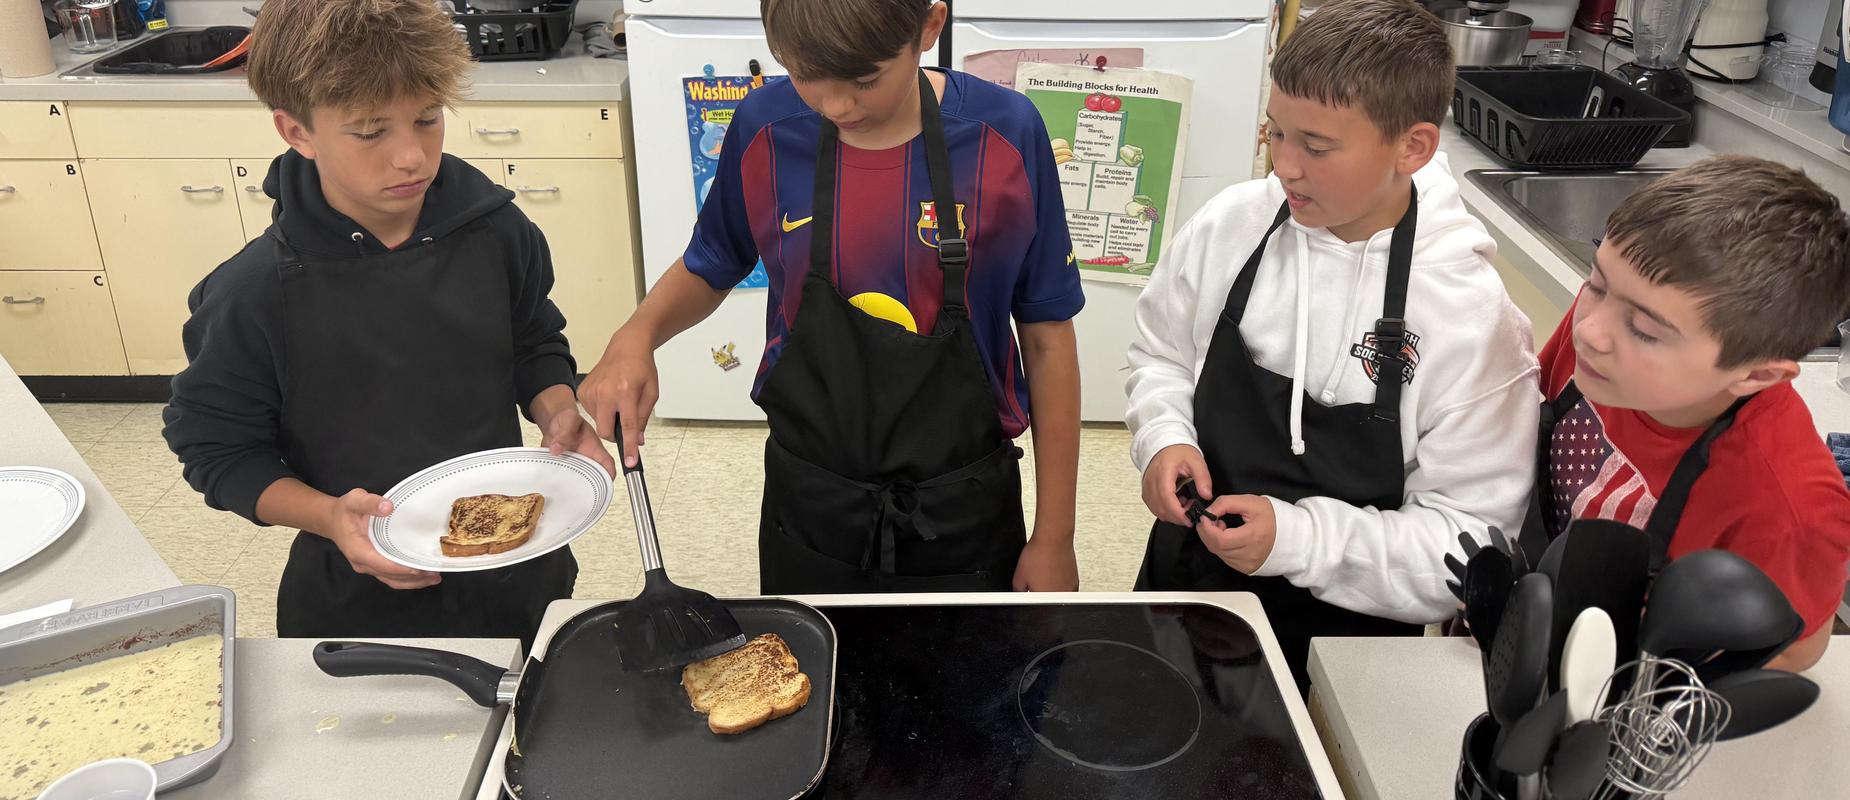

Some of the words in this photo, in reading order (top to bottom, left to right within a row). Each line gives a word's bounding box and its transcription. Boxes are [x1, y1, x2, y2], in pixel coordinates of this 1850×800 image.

[1028, 78, 1044, 86] The
[1046, 79, 1083, 90] Building
[1085, 82, 1113, 91] Blocks
[1115, 84, 1127, 92] for
[1129, 85, 1159, 94] Health
[49, 104, 61, 116] A
[600, 109, 609, 121] E
[1079, 113, 1122, 121] Carbohydrates
[66, 164, 76, 176] B
[236, 166, 247, 177] D
[508, 164, 515, 175] F
[1104, 168, 1132, 176] Proteins
[1072, 213, 1099, 221] Minerals
[94, 275, 104, 287] C
